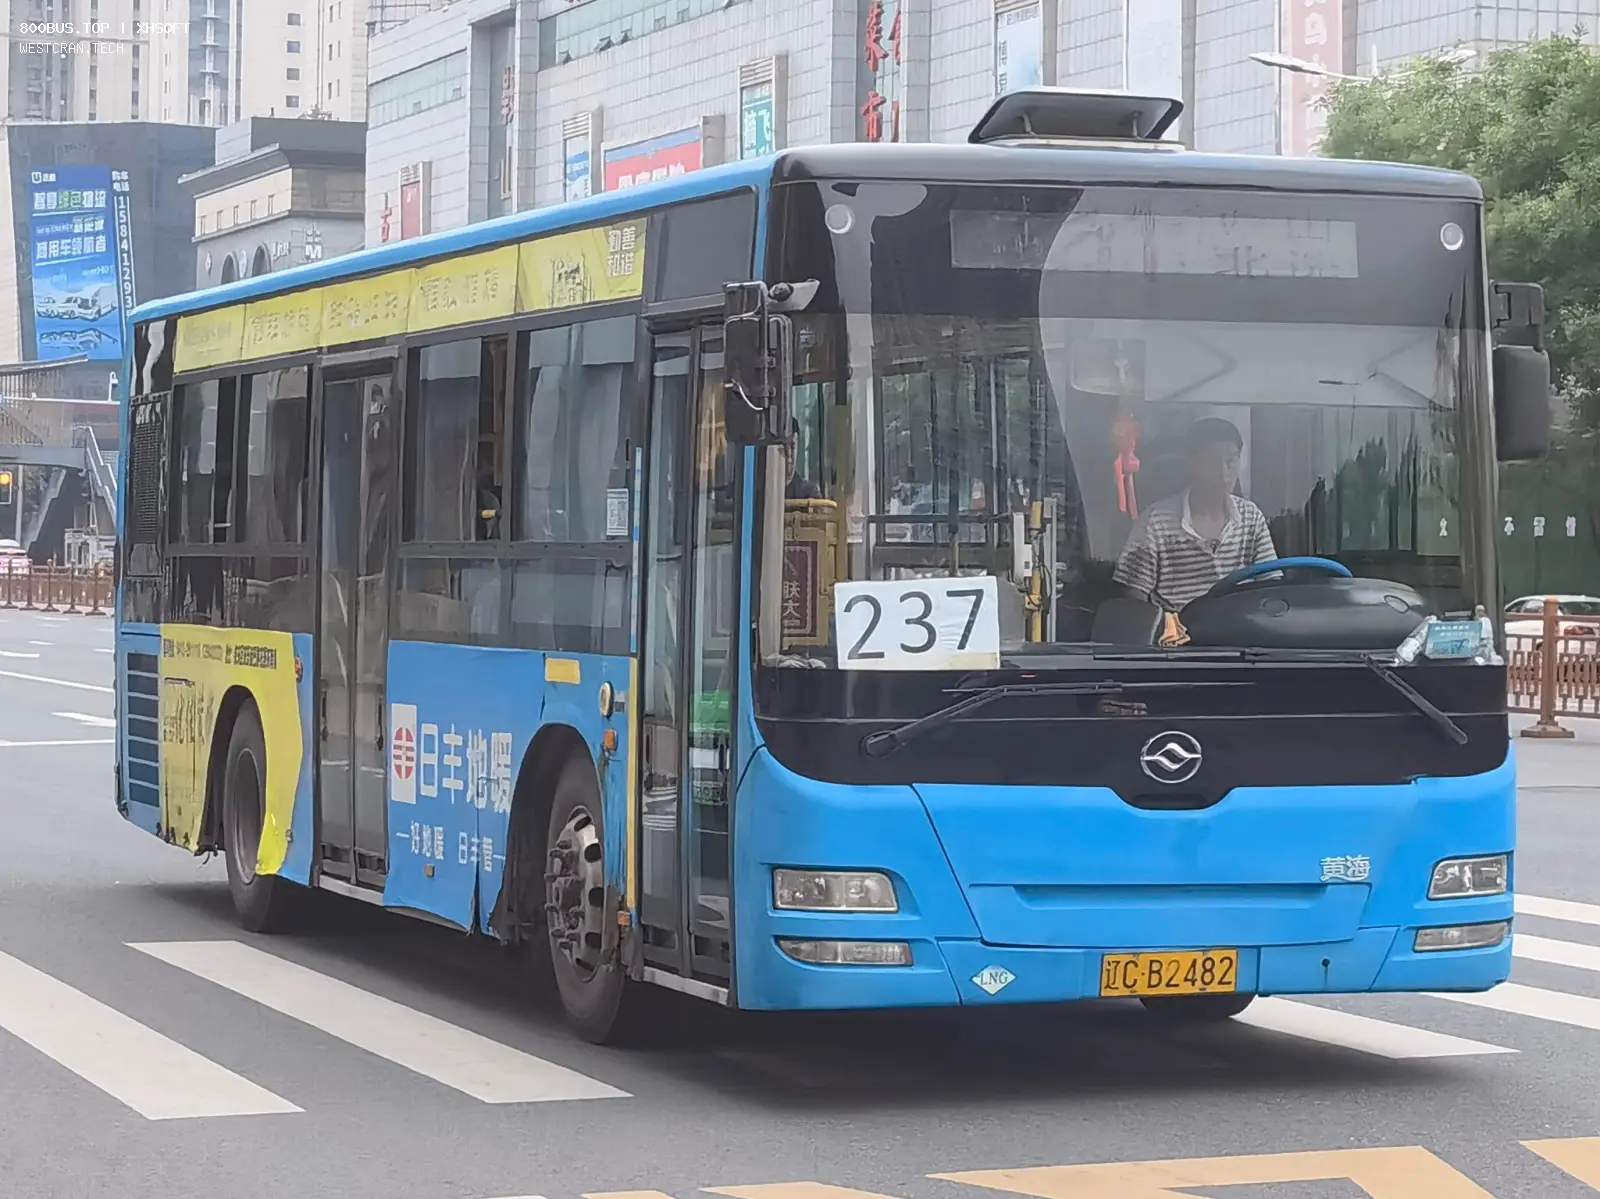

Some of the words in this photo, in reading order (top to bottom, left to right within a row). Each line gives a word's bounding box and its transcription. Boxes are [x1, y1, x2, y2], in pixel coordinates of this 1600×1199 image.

[113, 181, 130, 192] 电话
[117, 195, 133, 314] 15841293
[842, 588, 985, 661] 237
[420, 723, 512, 814] 日丰地暖
[1320, 854, 1371, 881] 黄海
[979, 971, 1009, 986] LNG
[1104, 956, 1234, 991] 辽C·B2482
